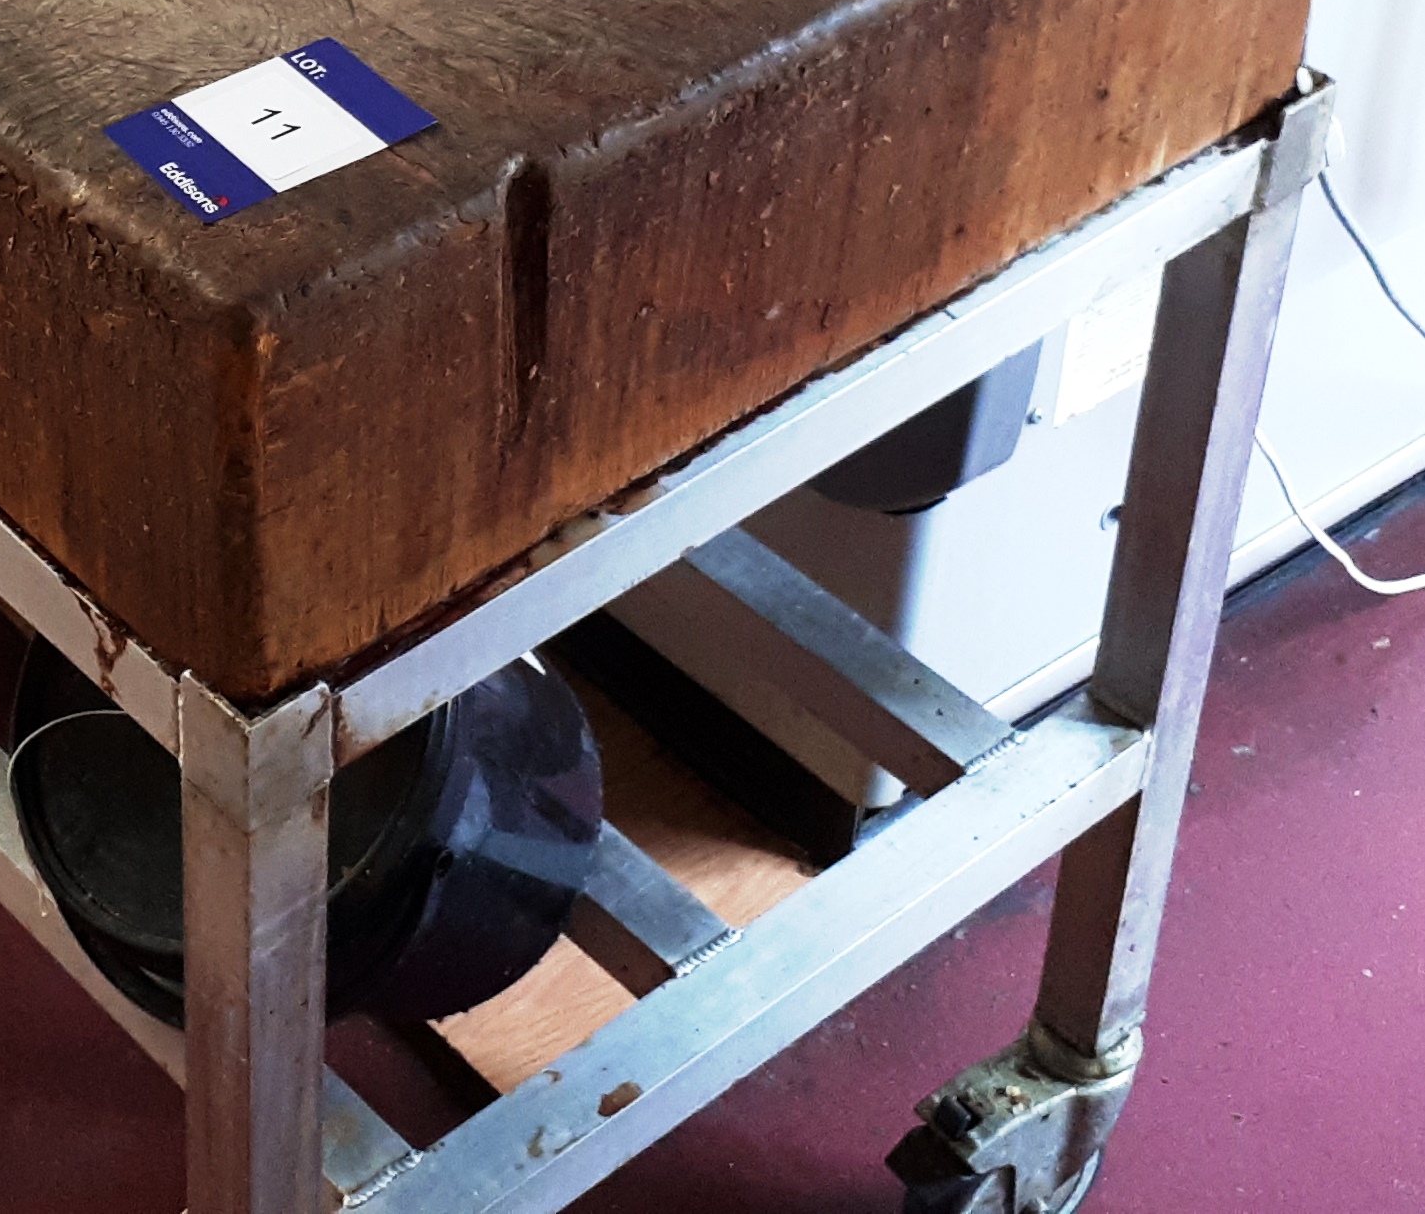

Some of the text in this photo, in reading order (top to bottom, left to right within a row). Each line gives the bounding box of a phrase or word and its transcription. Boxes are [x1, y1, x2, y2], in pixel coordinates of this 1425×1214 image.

[291, 52, 325, 80] LOT:
[251, 108, 301, 140] 11
[159, 162, 219, 213] Eddisons
